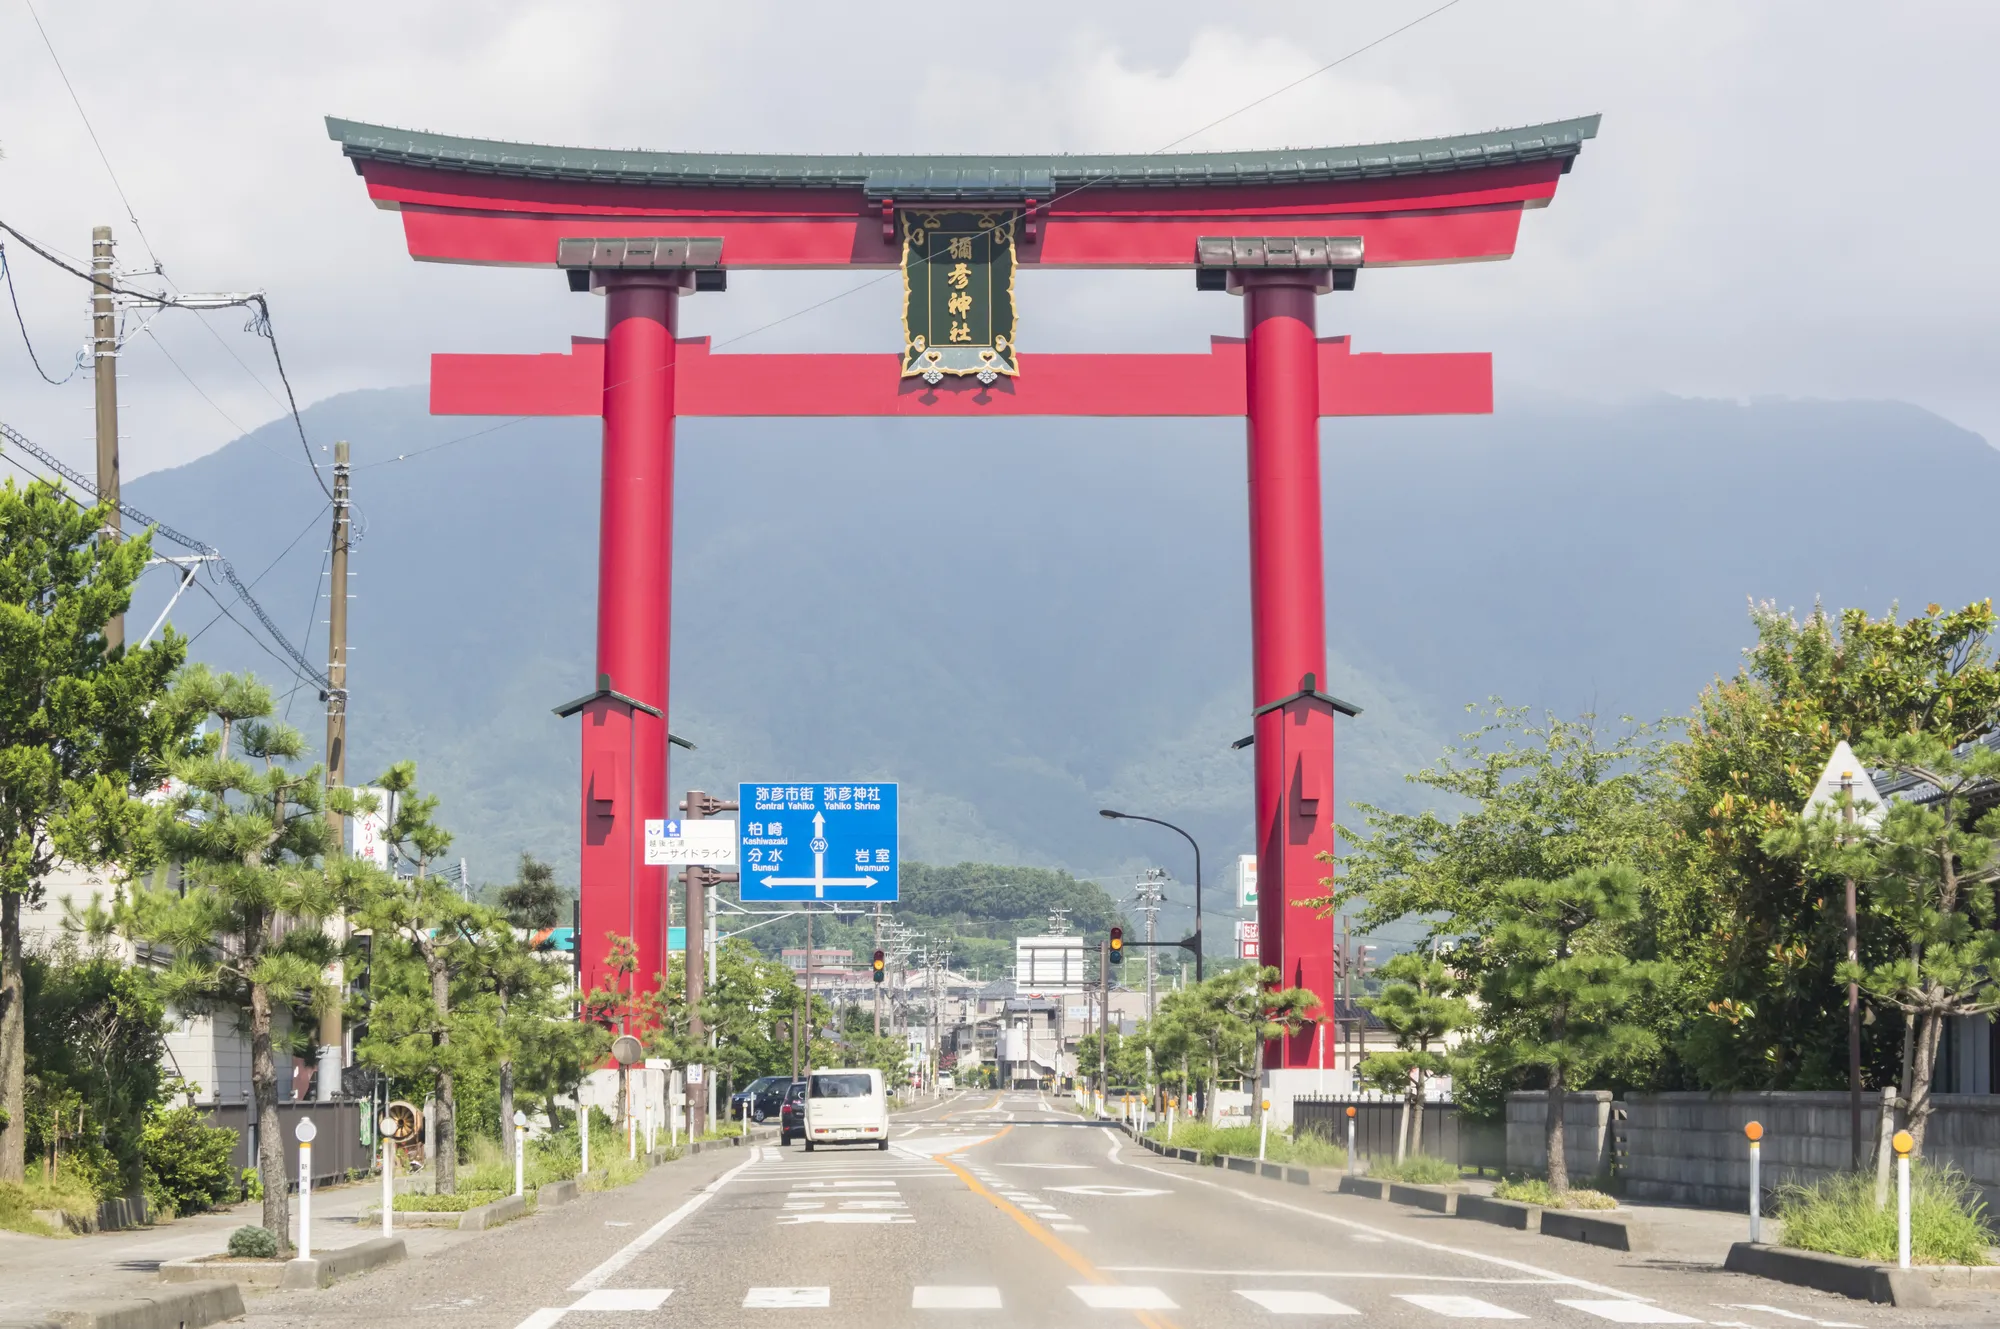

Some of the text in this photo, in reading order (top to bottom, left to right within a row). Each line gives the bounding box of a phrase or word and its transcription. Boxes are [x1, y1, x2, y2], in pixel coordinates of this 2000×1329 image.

[756, 786, 814, 801] 弥彦市街
[823, 786, 881, 801] 弥彦神社
[755, 802, 815, 810] Central Yahiko
[824, 802, 881, 810] Yahiko Shrine
[748, 822, 783, 836] 柏崎
[743, 837, 788, 845] Kashiwazaki
[813, 840, 825, 850] 29
[650, 849, 731, 858] シーサイドライン
[747, 848, 783, 862] 分水
[855, 848, 890, 863] 岩室
[752, 863, 779, 871] Bunsui
[855, 864, 890, 872] Iwamuro
